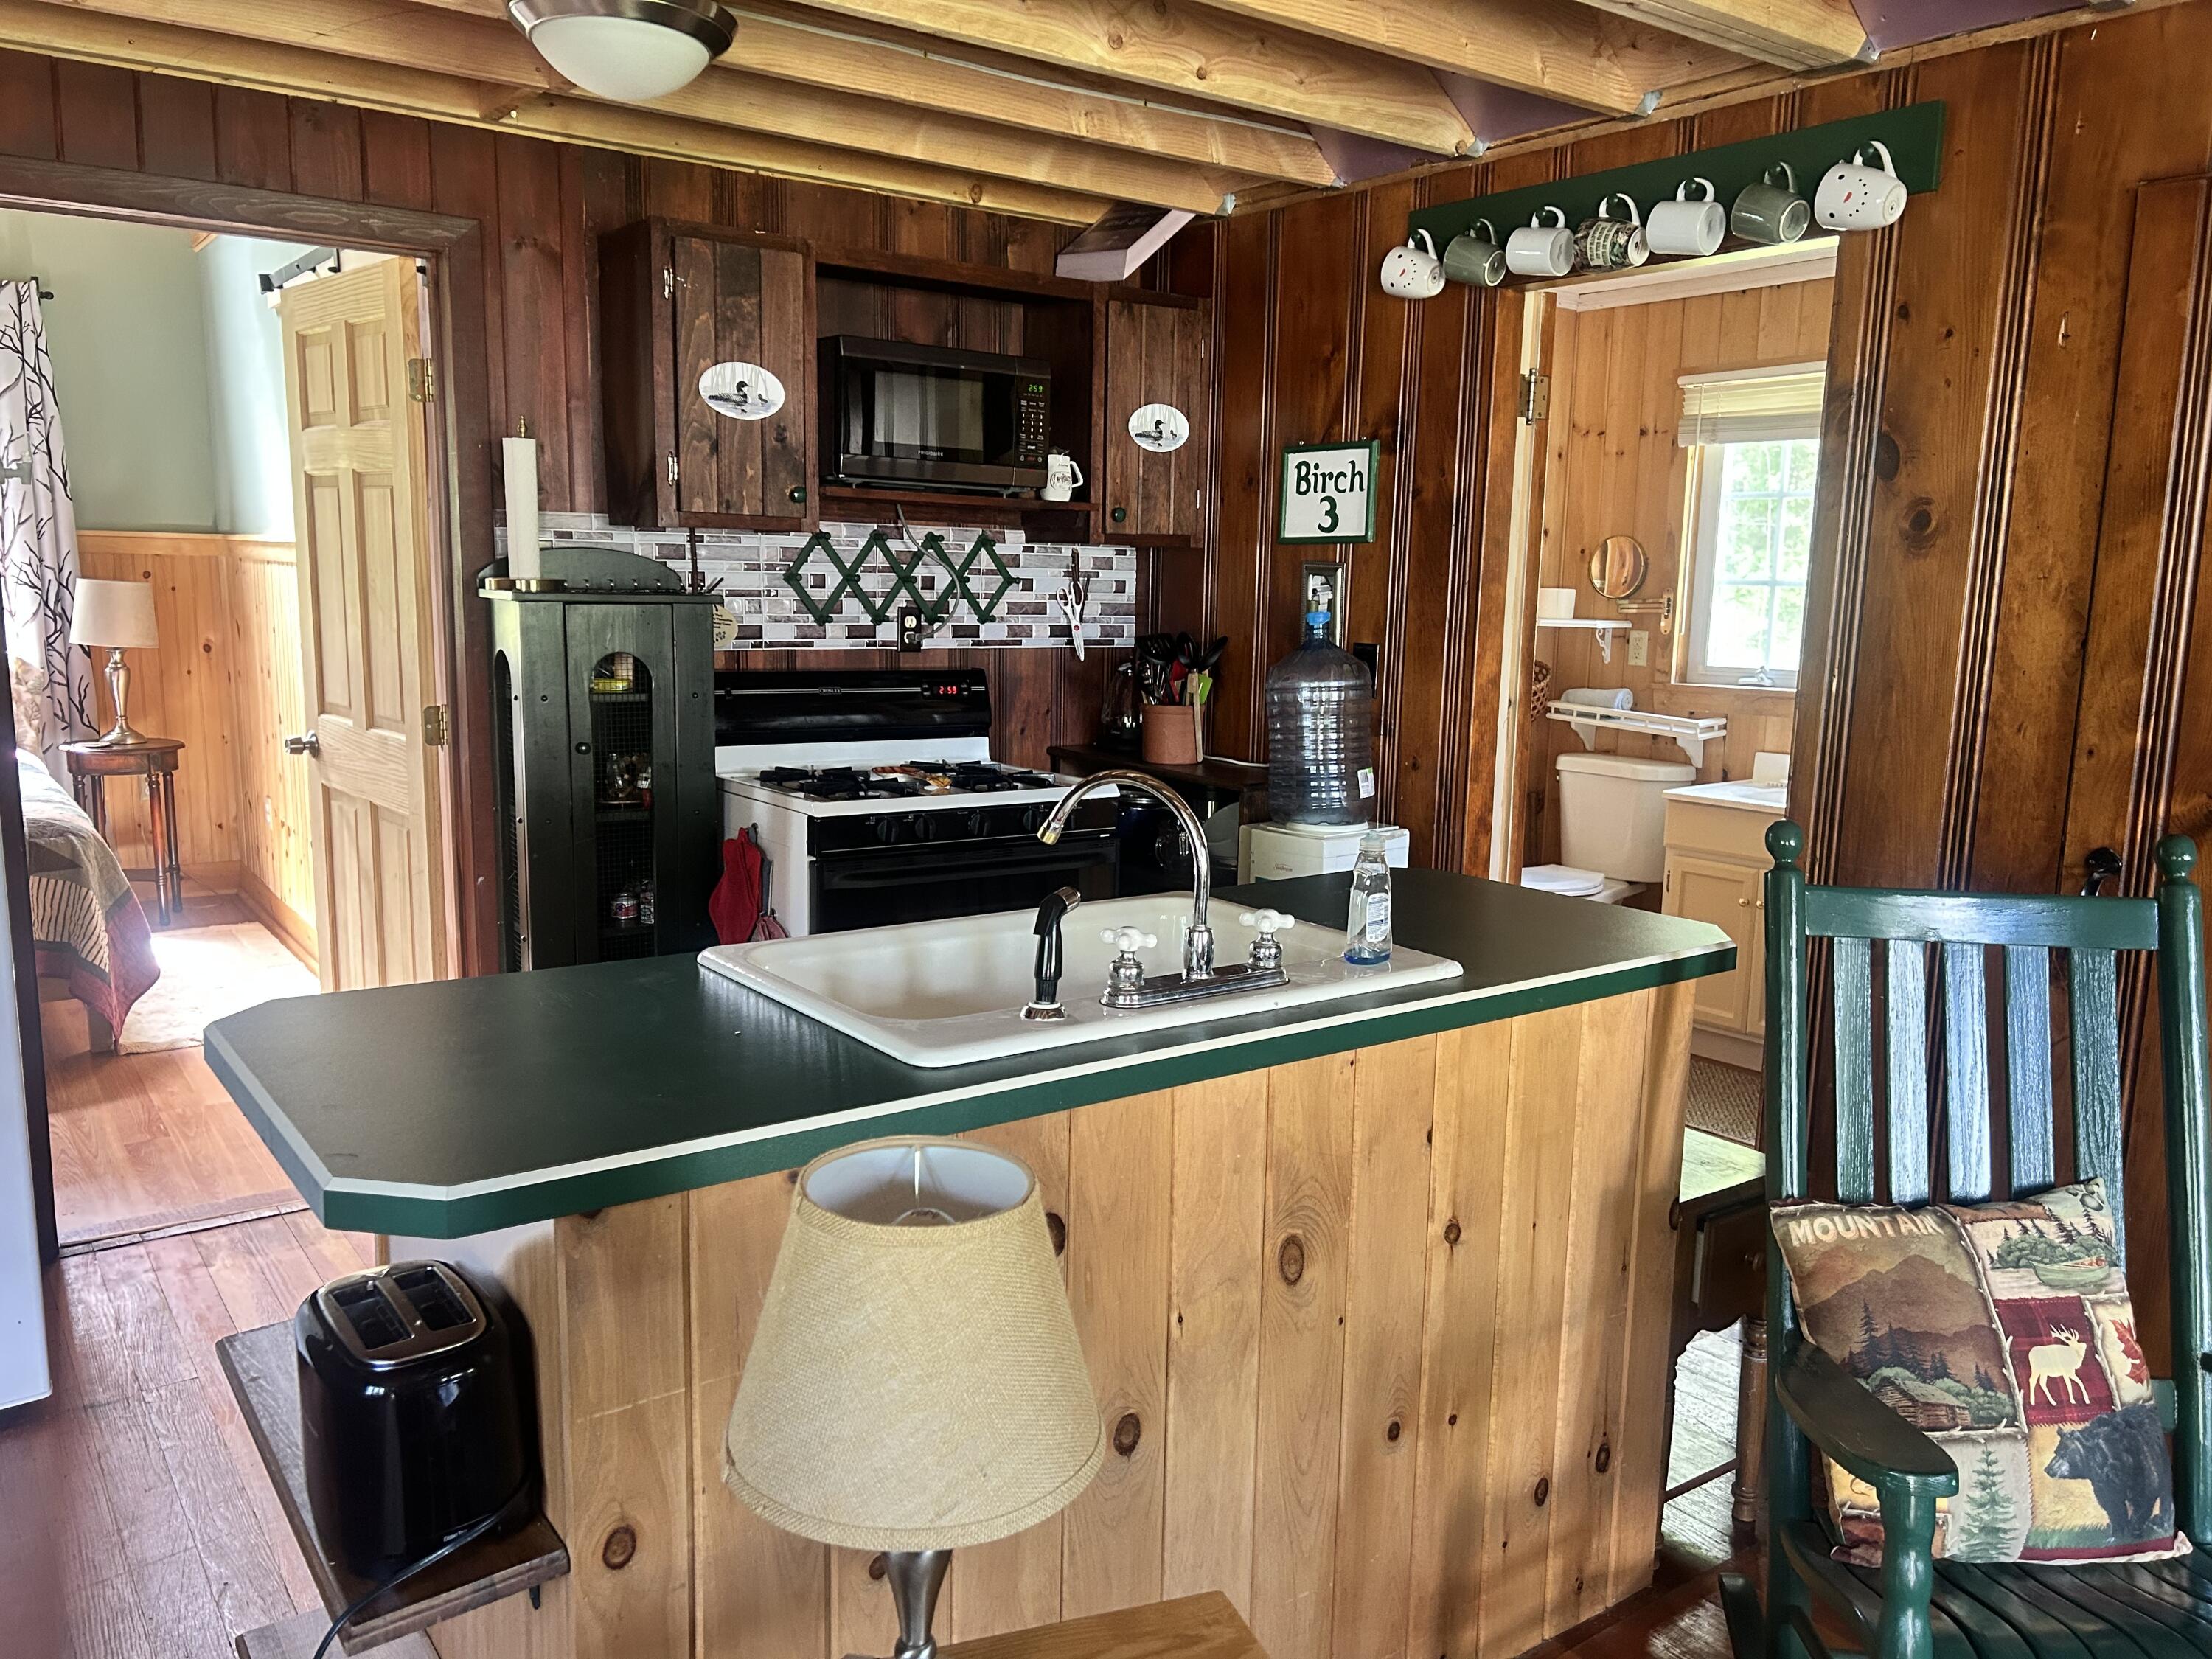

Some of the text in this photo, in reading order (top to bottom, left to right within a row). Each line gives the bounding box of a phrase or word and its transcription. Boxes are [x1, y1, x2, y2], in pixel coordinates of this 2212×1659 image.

[1294, 459, 1365, 495] Birch
[1318, 495, 1339, 533] 3
[1787, 1214, 1945, 1248] MOUNTAIN
